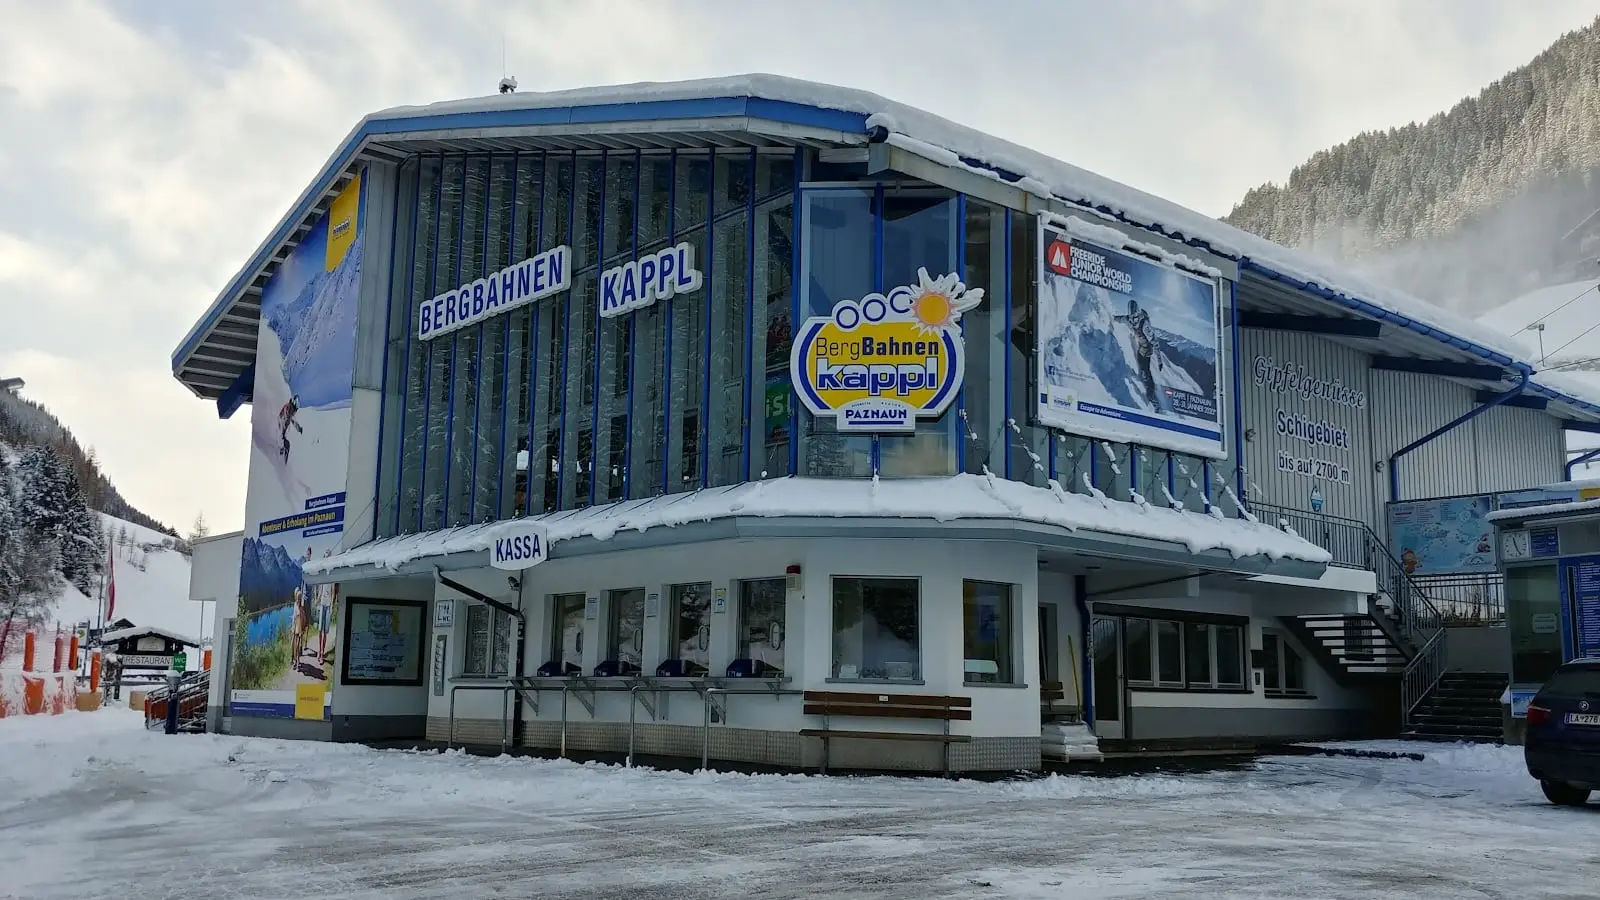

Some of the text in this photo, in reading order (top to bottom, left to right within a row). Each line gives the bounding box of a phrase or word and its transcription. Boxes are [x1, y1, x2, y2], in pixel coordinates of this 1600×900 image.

[1071, 246, 1106, 267] FREERIDE
[1071, 257, 1131, 284] JUNIOR WORLD
[1071, 266, 1132, 294] CHAMPIONSHIP
[420, 248, 692, 336] BERGBAHNEN KAPPL
[816, 336, 939, 360] BergBahnen
[816, 356, 938, 396] kappl
[1254, 357, 1364, 409] Gipfelgenüsse
[845, 408, 907, 419] PAZNAUN
[1277, 410, 1348, 449] Schigebiet
[1279, 452, 1349, 482] bis auf 2700 m
[287, 517, 307, 528] Erholung
[496, 534, 541, 562] KASSA
[174, 656, 186, 664] WC
[1570, 714, 1580, 723] LA
